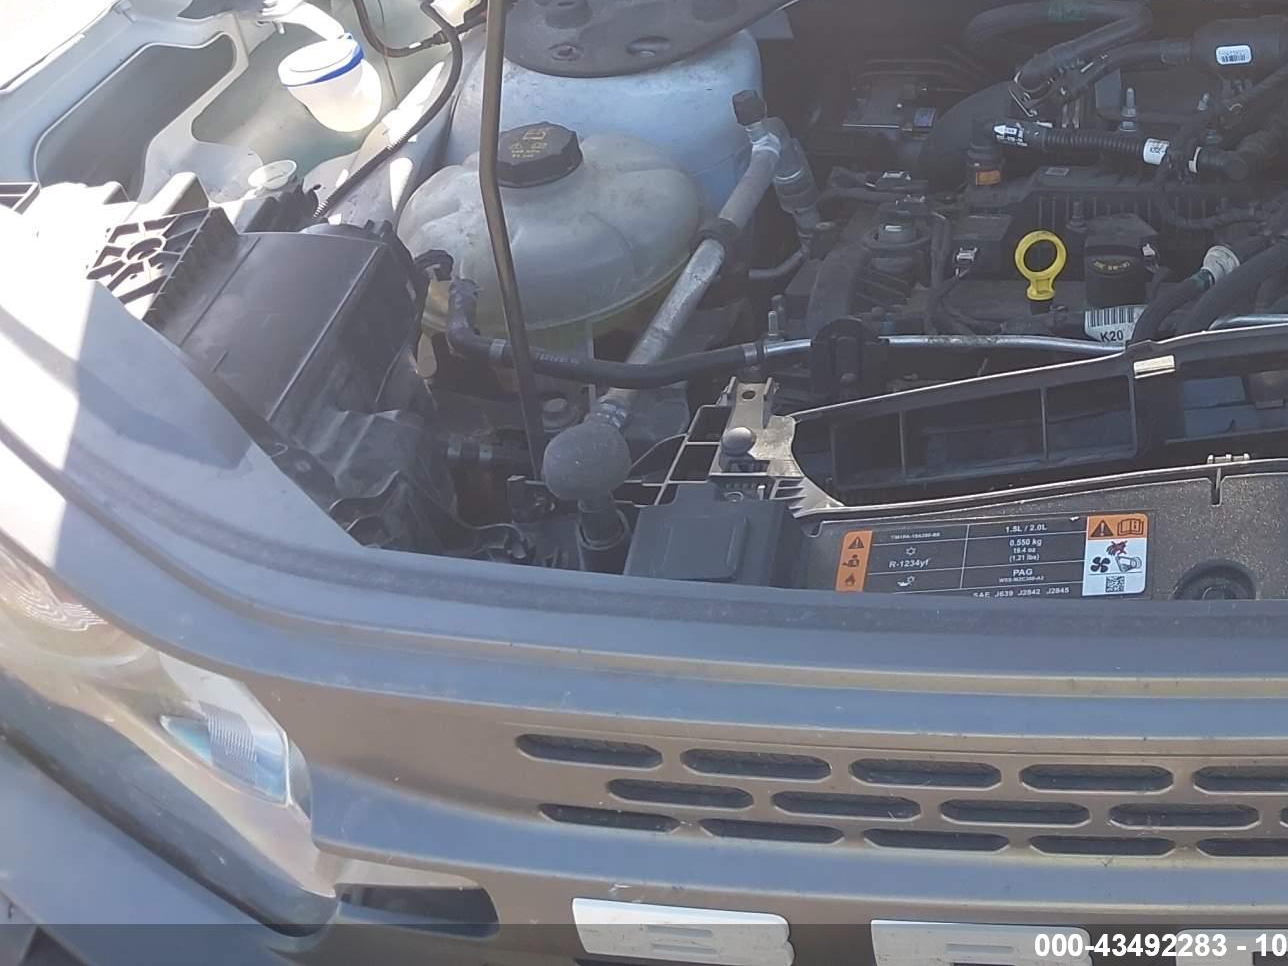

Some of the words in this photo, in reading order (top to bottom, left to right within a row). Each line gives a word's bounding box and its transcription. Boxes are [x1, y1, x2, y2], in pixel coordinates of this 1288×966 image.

[1009, 538, 1031, 546] 0.550
[1032, 538, 1042, 546] kg
[888, 558, 930, 568] R-1234yf
[1012, 568, 1033, 576] PAG
[994, 590, 1014, 598] J639
